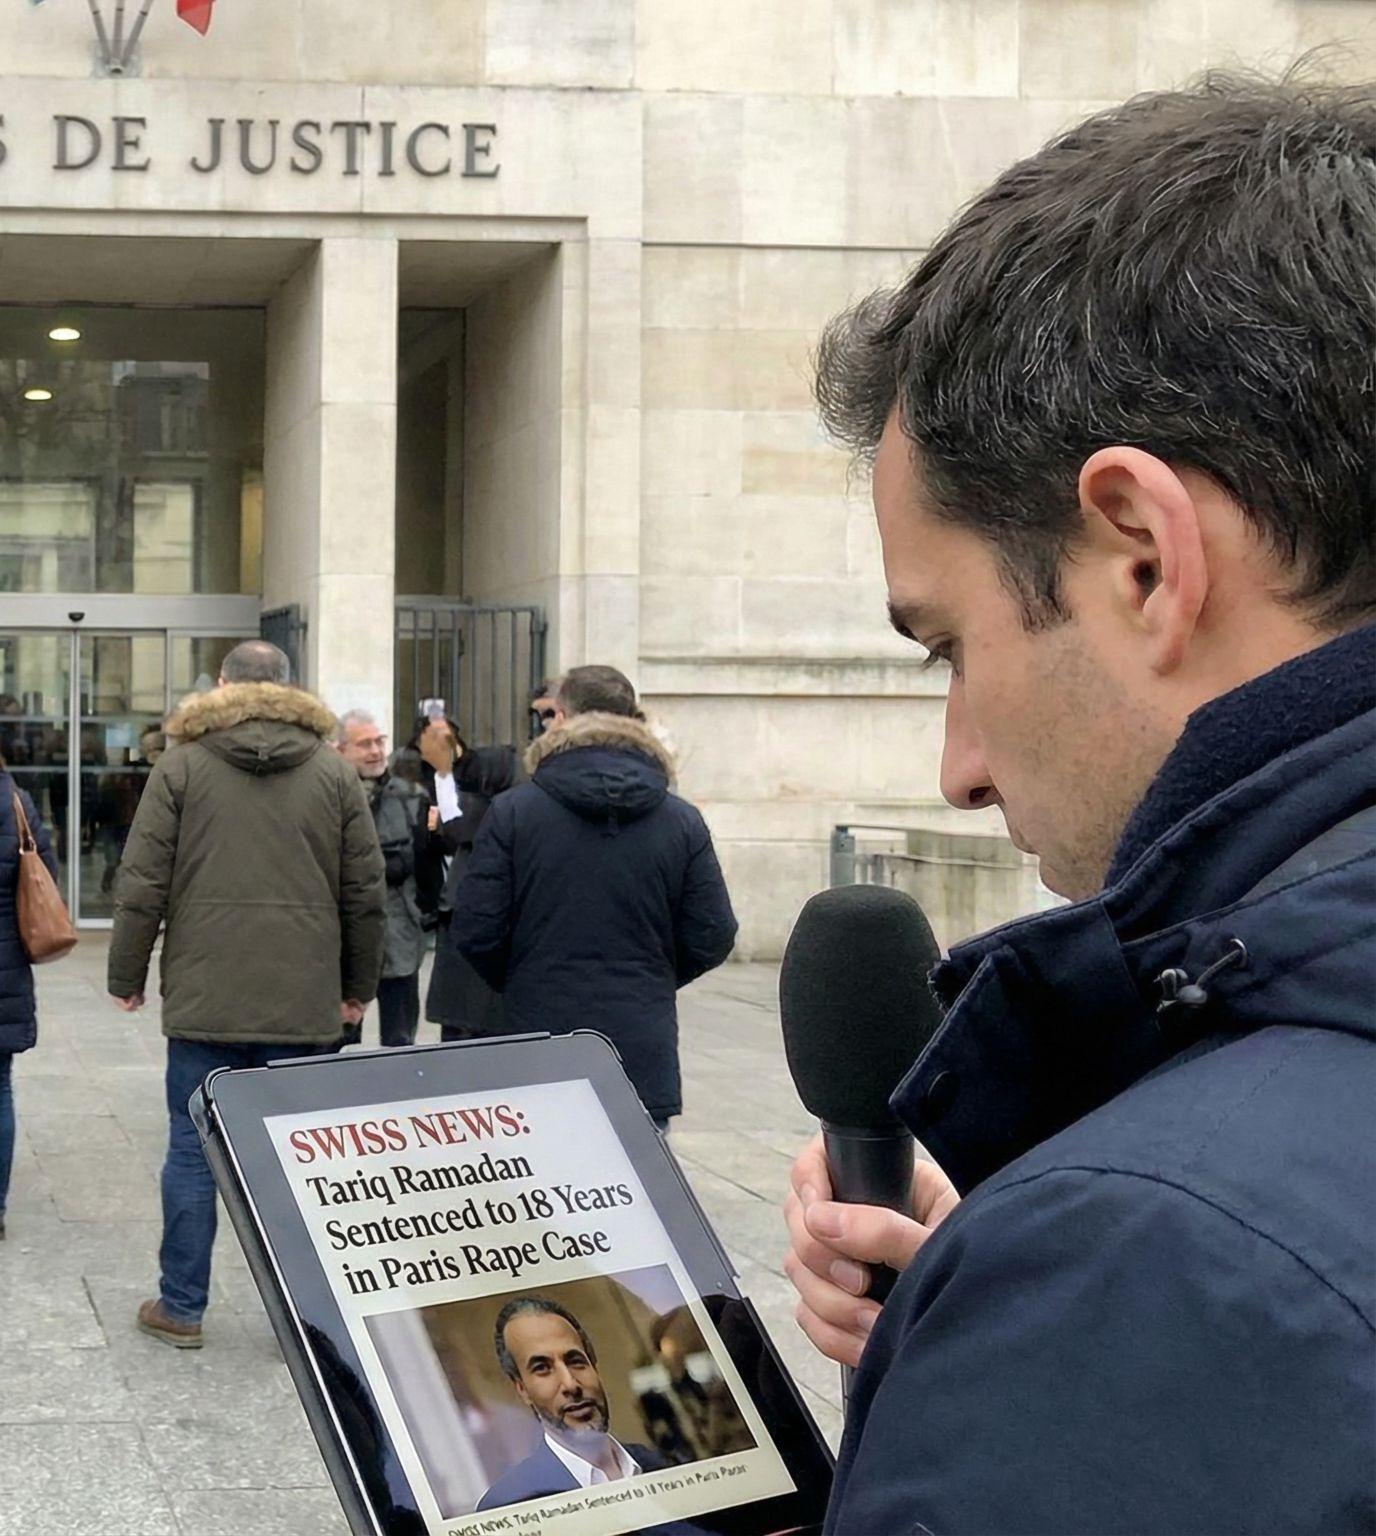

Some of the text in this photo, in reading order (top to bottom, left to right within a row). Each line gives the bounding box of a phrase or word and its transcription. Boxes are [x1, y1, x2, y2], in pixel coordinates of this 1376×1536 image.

[52, 113, 151, 172] DE
[191, 119, 501, 178] JUSTICE
[289, 1105, 531, 1164] SWISS NEWS:
[306, 1152, 535, 1207] Tariq Ramadan
[325, 1183, 634, 1251] Sentenced to 18 Years
[343, 1229, 612, 1295] in Paris Rape Case
